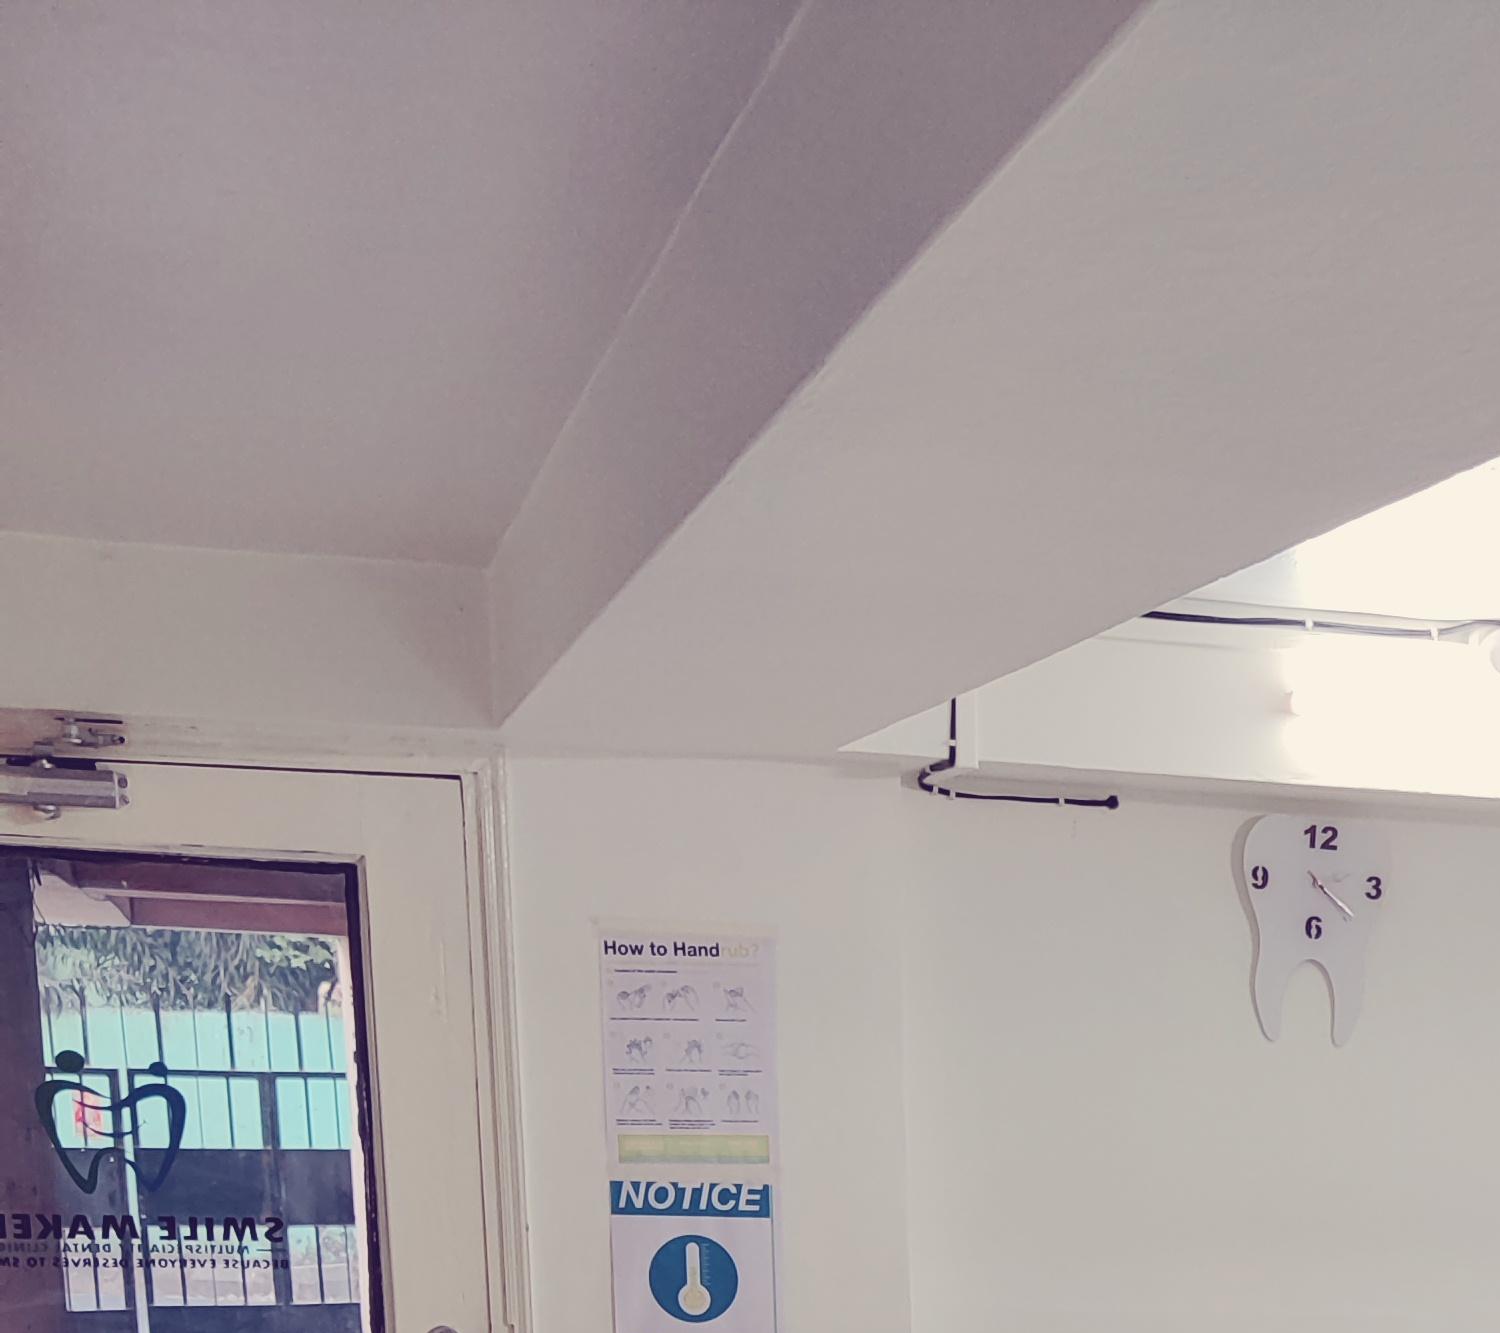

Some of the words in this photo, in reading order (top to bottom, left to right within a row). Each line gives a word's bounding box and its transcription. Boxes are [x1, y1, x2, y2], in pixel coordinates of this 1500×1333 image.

[1304, 825, 1339, 851] 12
[1251, 865, 1269, 890] 9
[1365, 876, 1383, 900] 3
[1305, 916, 1323, 939] 6
[603, 940, 643, 956] How
[650, 941, 668, 956] to
[618, 1180, 764, 1212] NOTICE
